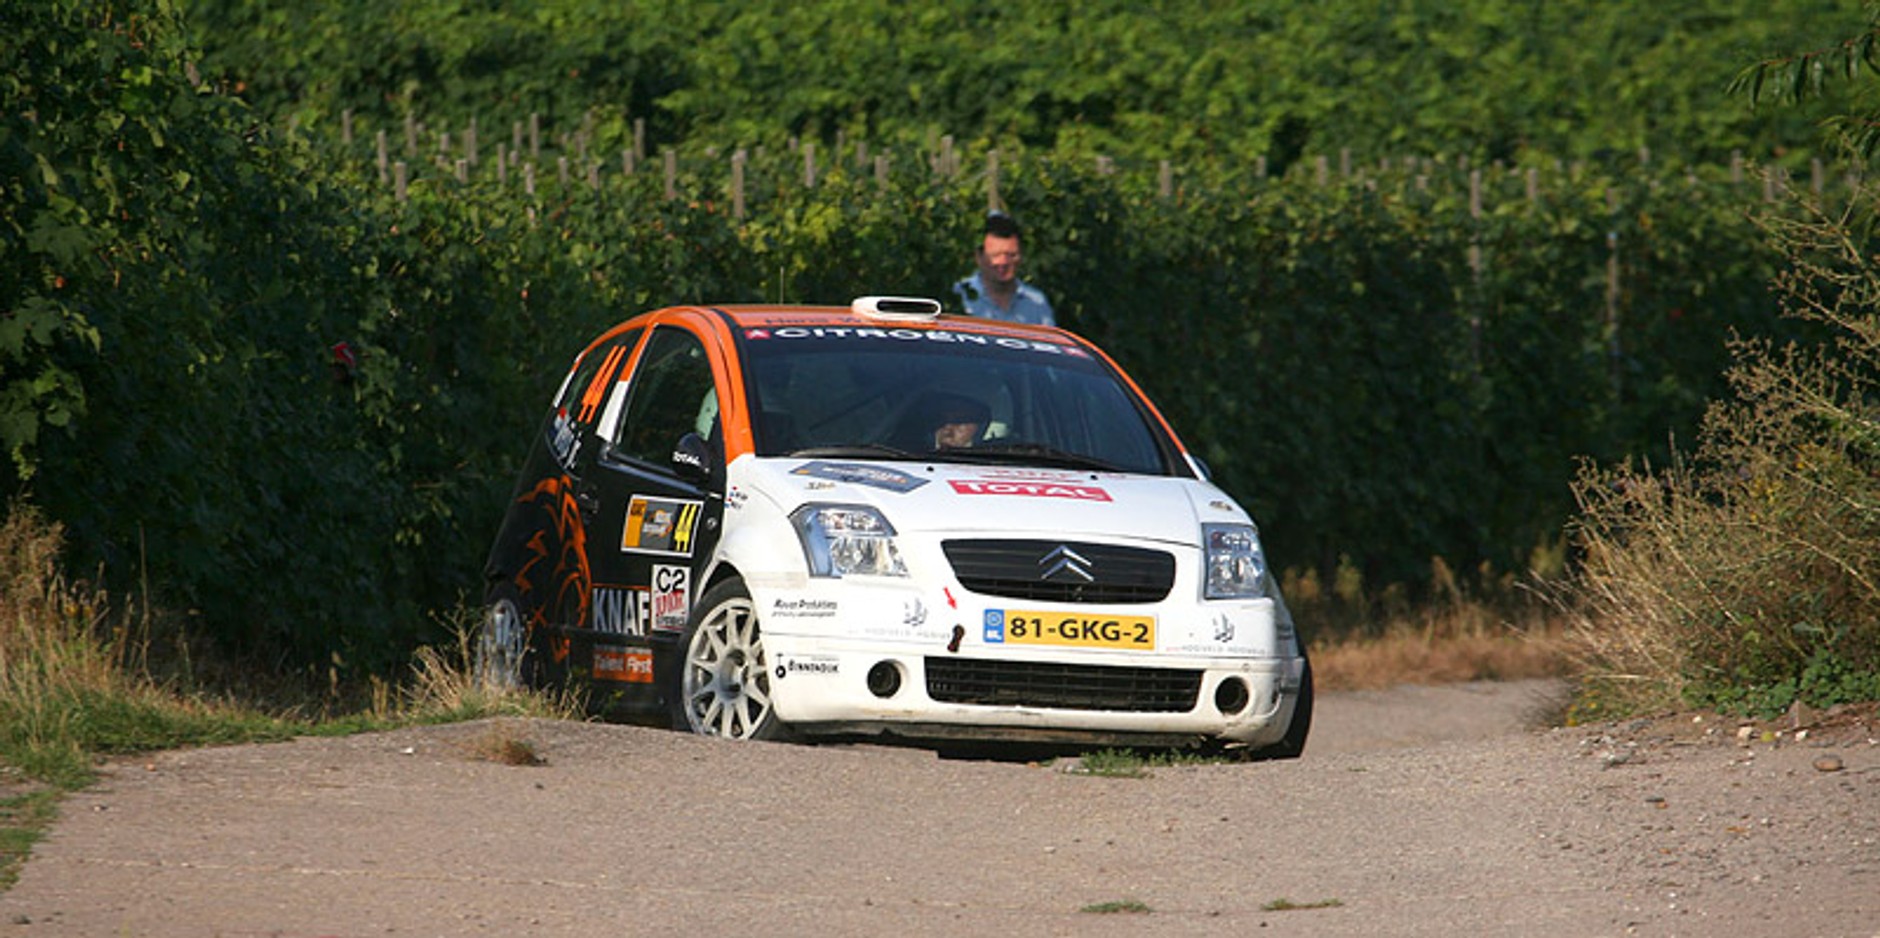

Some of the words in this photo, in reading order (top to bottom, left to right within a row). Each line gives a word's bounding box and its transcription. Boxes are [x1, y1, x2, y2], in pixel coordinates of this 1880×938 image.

[955, 482, 1108, 500] TOTAL
[674, 503, 697, 553] 44
[656, 567, 685, 592] C2
[593, 588, 650, 636] KNAF
[1010, 616, 1149, 644] 81-GKG-2
